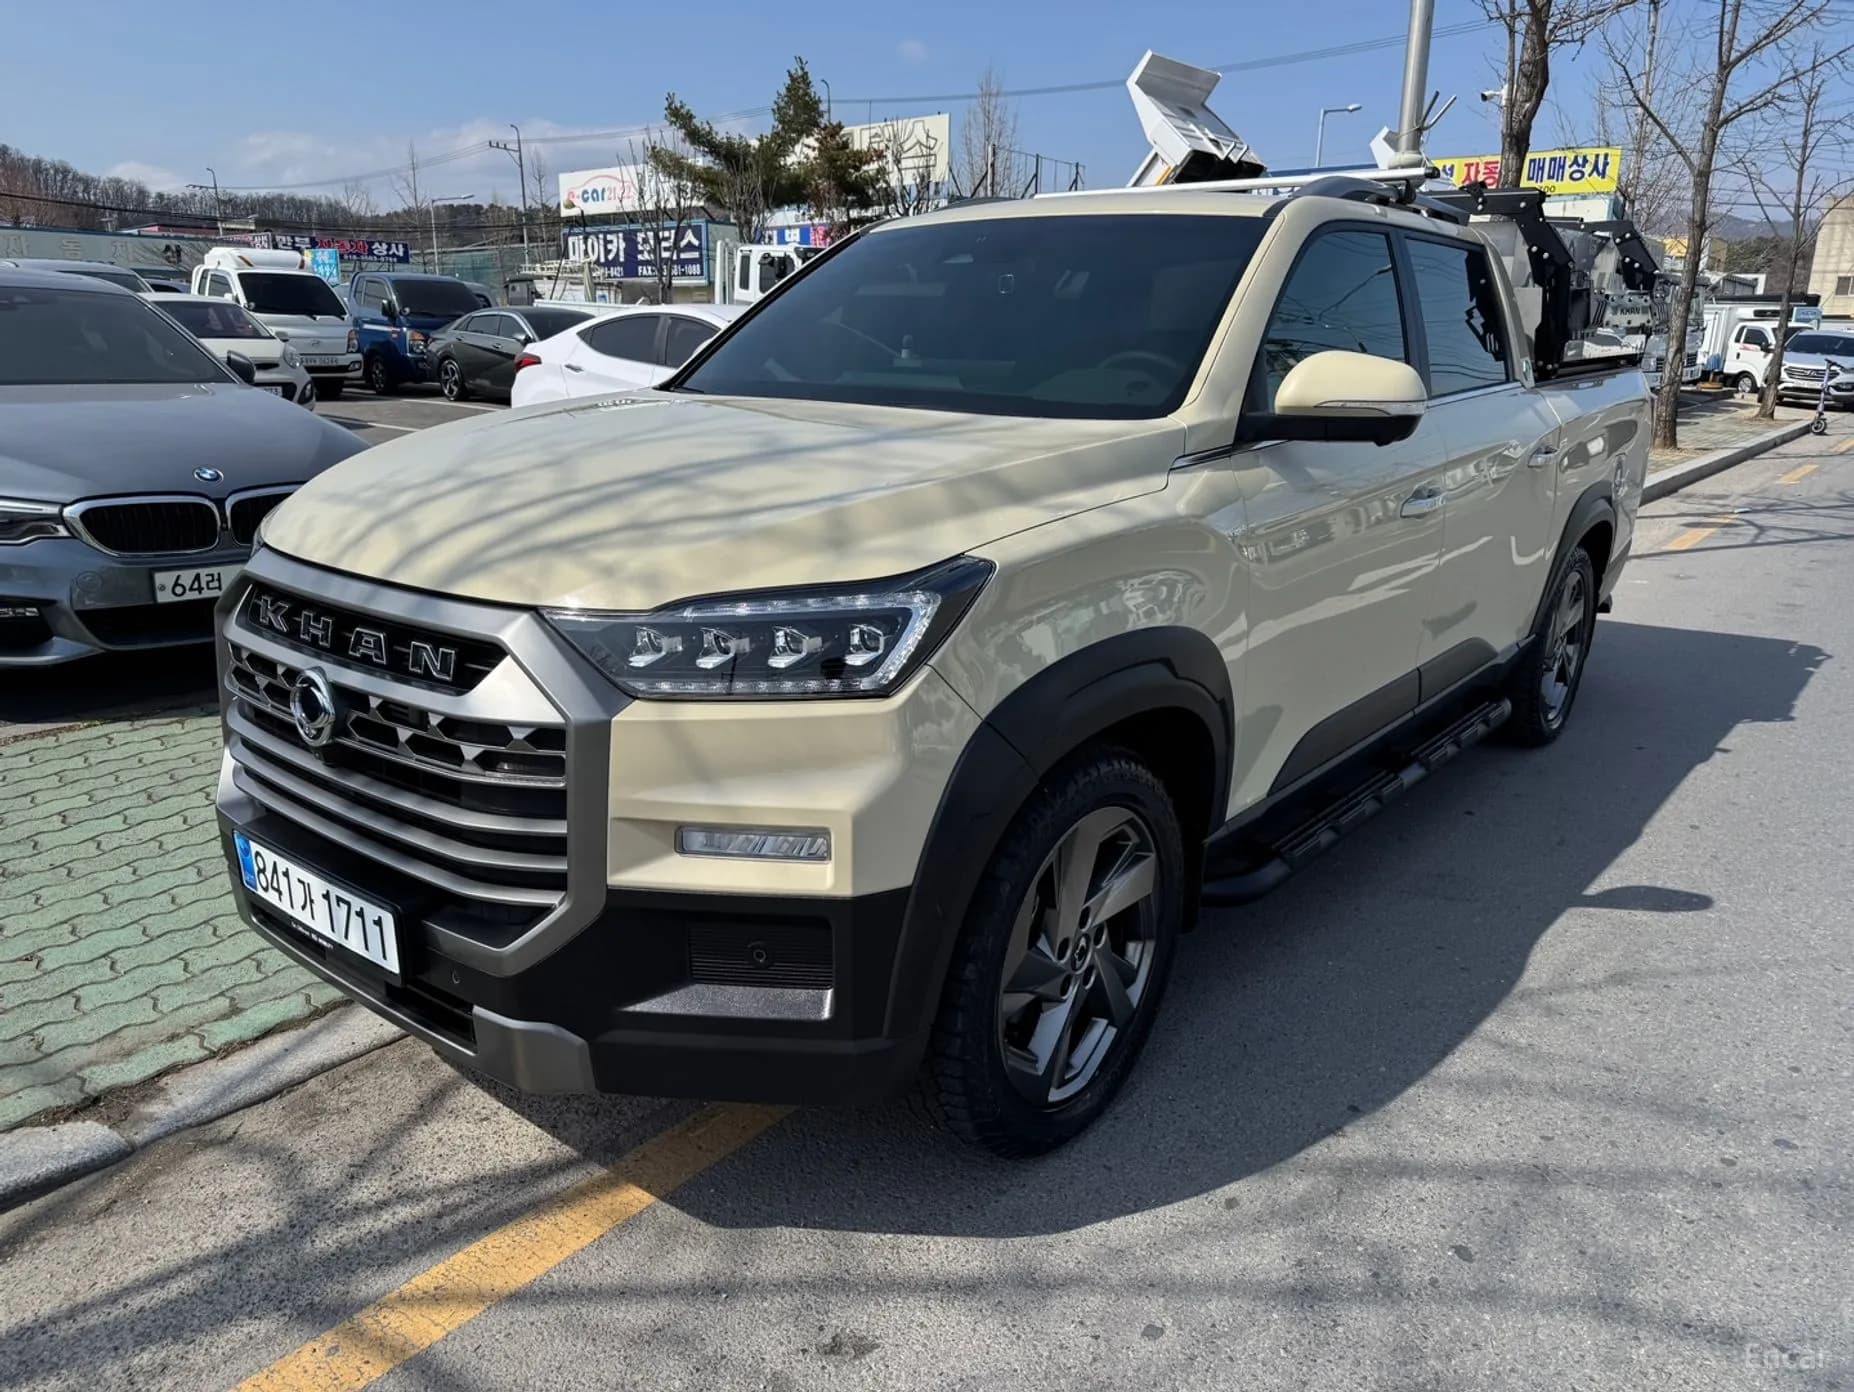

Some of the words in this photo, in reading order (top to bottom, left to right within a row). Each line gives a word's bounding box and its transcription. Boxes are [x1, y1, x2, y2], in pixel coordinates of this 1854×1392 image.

[1527, 153, 1610, 183] 매매상사
[371, 242, 405, 257] 상사
[568, 232, 626, 262] 마이카
[171, 572, 222, 597] 64러
[256, 596, 455, 680] KHAN
[255, 850, 315, 920] 841가
[322, 889, 387, 961] 1711
